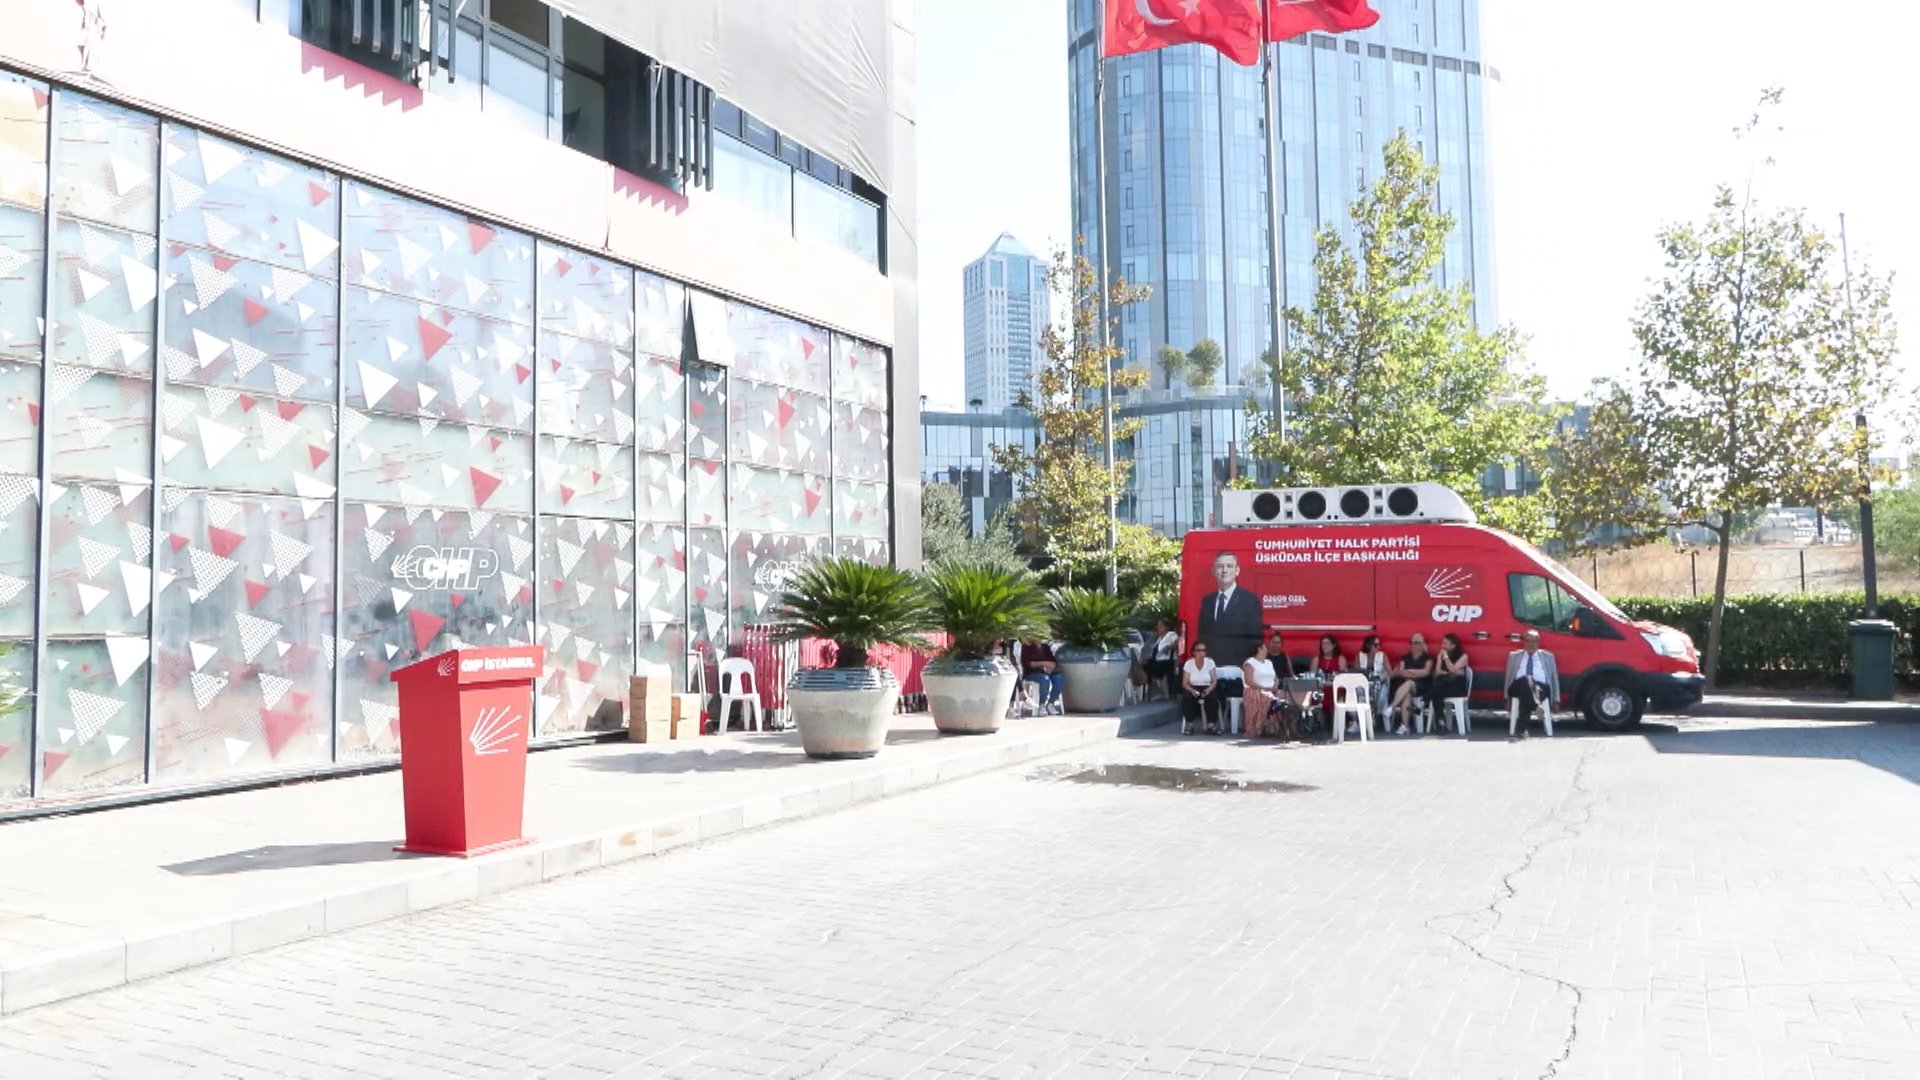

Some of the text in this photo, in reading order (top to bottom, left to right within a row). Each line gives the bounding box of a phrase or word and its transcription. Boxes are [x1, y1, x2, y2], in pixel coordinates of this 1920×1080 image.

[1255, 535, 1420, 550] CUMHURİYET HALK PARTİSİ
[1255, 550, 1419, 564] ÜSKÜDAR İLÇE BAŞKANLIĞI
[405, 545, 499, 590] CHP
[1432, 604, 1483, 622] CHP
[461, 656, 535, 672] CHP İSTANBUL
